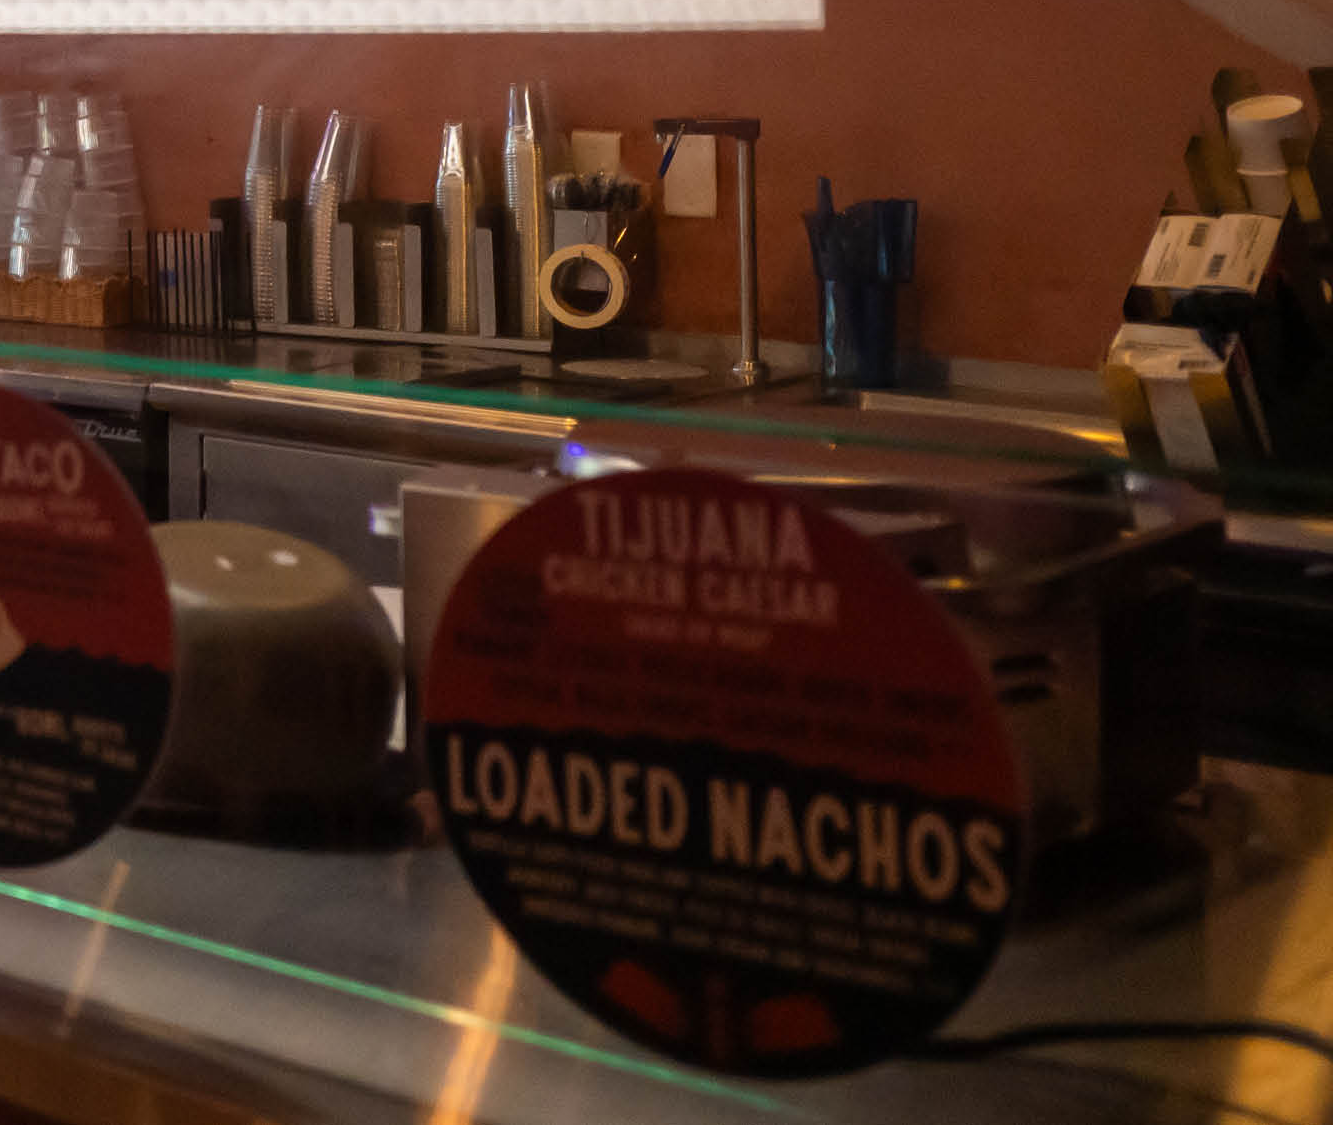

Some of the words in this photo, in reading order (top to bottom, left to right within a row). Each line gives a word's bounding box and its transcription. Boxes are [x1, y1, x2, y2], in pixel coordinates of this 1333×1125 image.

[578, 488, 816, 574] TIJUANA
[446, 733, 689, 852] LOADED
[708, 778, 1010, 914] NACHOS
